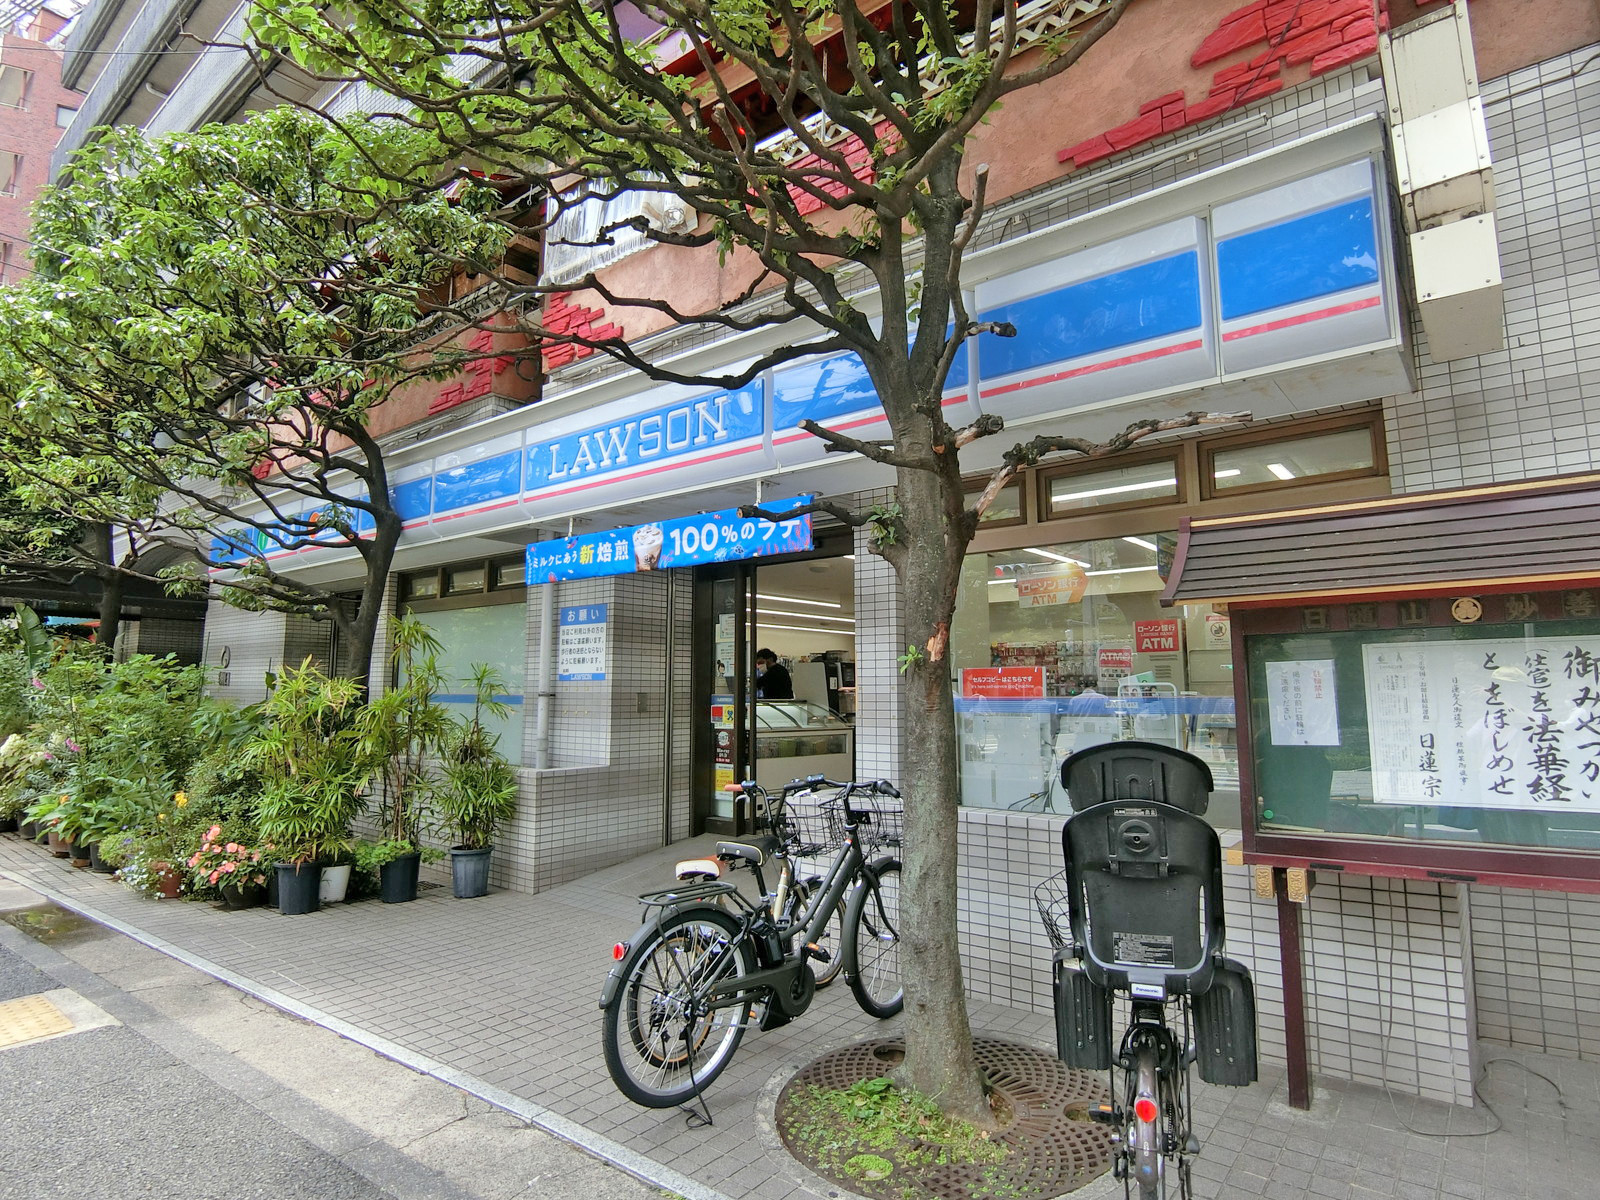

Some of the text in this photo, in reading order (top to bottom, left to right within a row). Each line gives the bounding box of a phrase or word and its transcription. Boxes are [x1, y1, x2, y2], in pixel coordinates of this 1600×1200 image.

[548, 396, 728, 480] LAWSON
[669, 517, 801, 556] 100%のラテ
[1021, 577, 1079, 593] ローソン銀行
[1031, 593, 1057, 606] ATM
[567, 608, 600, 622] お願い
[1137, 624, 1175, 633] ローソン銀行
[1141, 637, 1174, 650] ATM
[1482, 651, 1516, 796] とをぼしめせ
[1418, 732, 1443, 798] 日蓮宗
[1135, 986, 1159, 994] Panasonic
